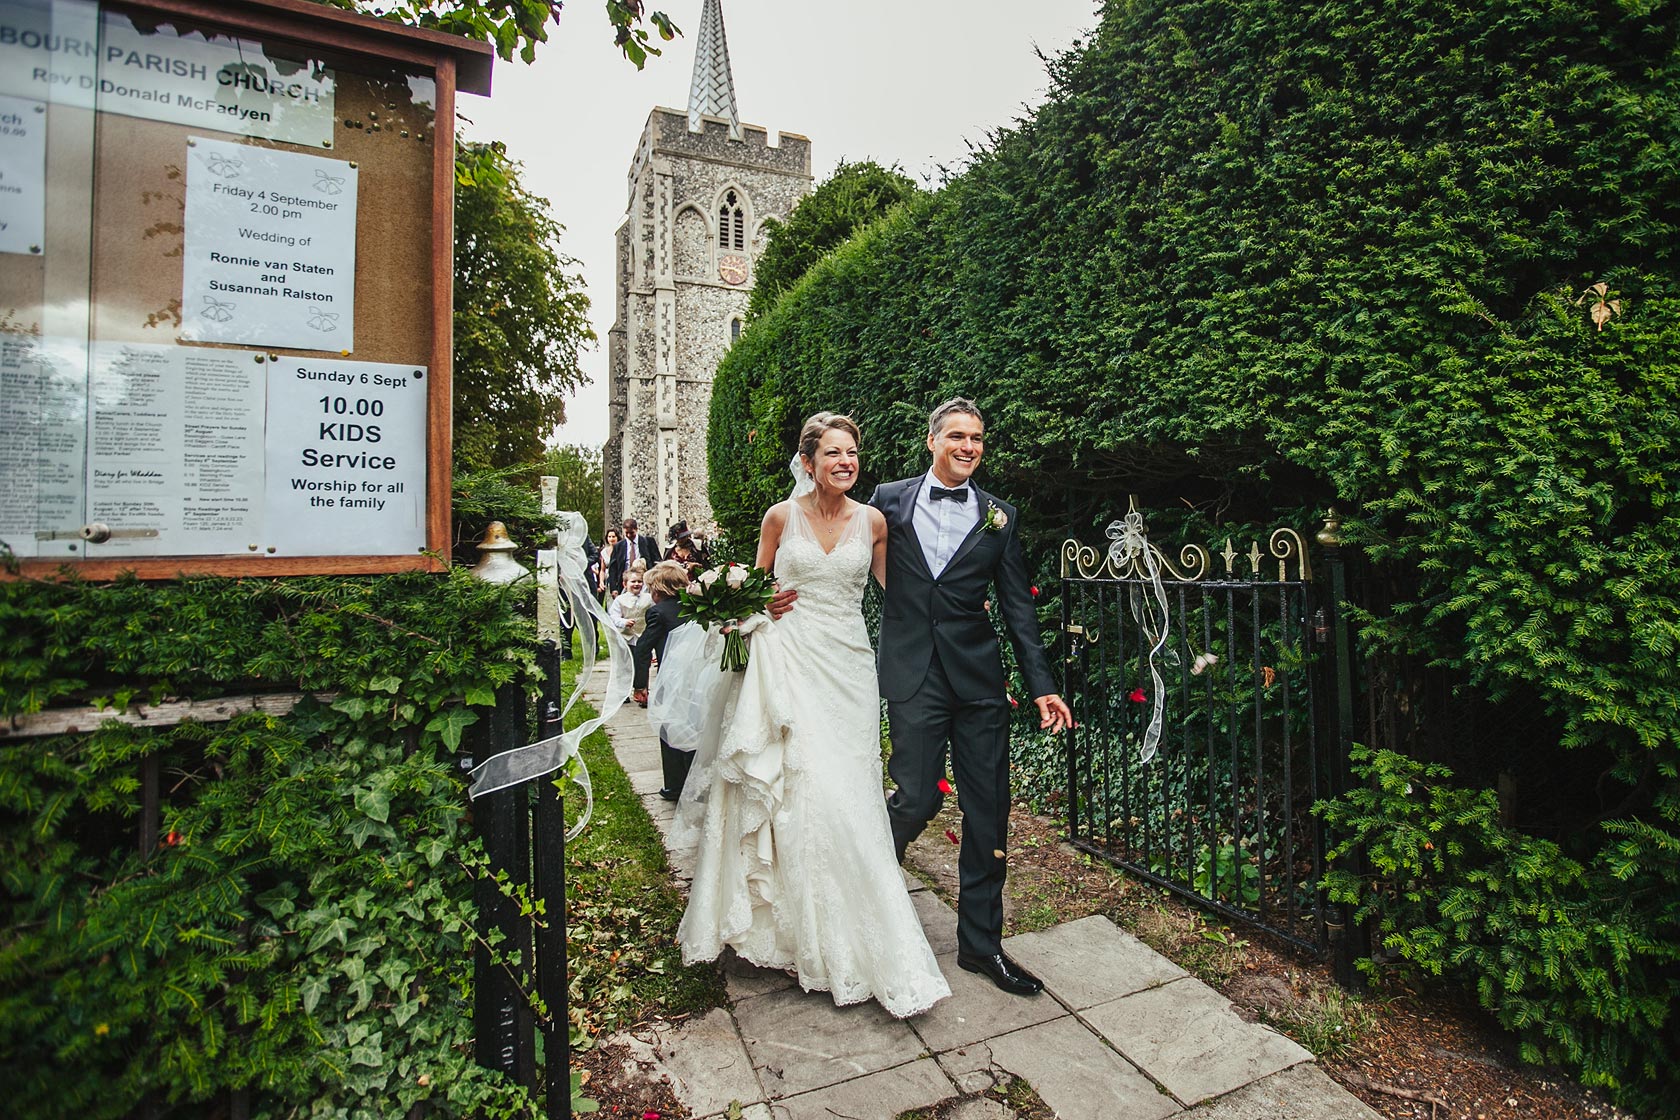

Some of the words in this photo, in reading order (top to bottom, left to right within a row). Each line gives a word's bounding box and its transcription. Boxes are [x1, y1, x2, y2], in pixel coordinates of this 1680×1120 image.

[106, 46, 206, 80] PARISH
[216, 68, 319, 102] CHURCH
[33, 67, 72, 85] Rev
[101, 79, 170, 104] Donald
[177, 95, 271, 122] McFadyen
[213, 183, 254, 200] Friday
[258, 190, 266, 200] 4
[270, 192, 338, 211] September
[250, 202, 279, 216] 2.00
[282, 209, 302, 219] pm
[238, 227, 295, 247] Wedding
[298, 236, 311, 247] of
[210, 252, 260, 267] Ronnie
[264, 260, 288, 270] van
[292, 262, 334, 275] Staten
[260, 274, 286, 283] and
[209, 280, 278, 296] Susannah
[283, 287, 333, 302] Ralston
[296, 367, 355, 386] Sunday
[360, 373, 369, 384] 6
[373, 374, 407, 389] Sept
[319, 396, 384, 417] 10.00
[319, 422, 382, 443] KIDS
[302, 448, 396, 470] Service
[94, 470, 115, 480] Diary
[117, 469, 128, 479] for
[291, 478, 357, 494] Worship
[361, 481, 383, 493] for
[387, 482, 404, 493] all
[310, 496, 335, 507] the
[340, 496, 386, 511] family
